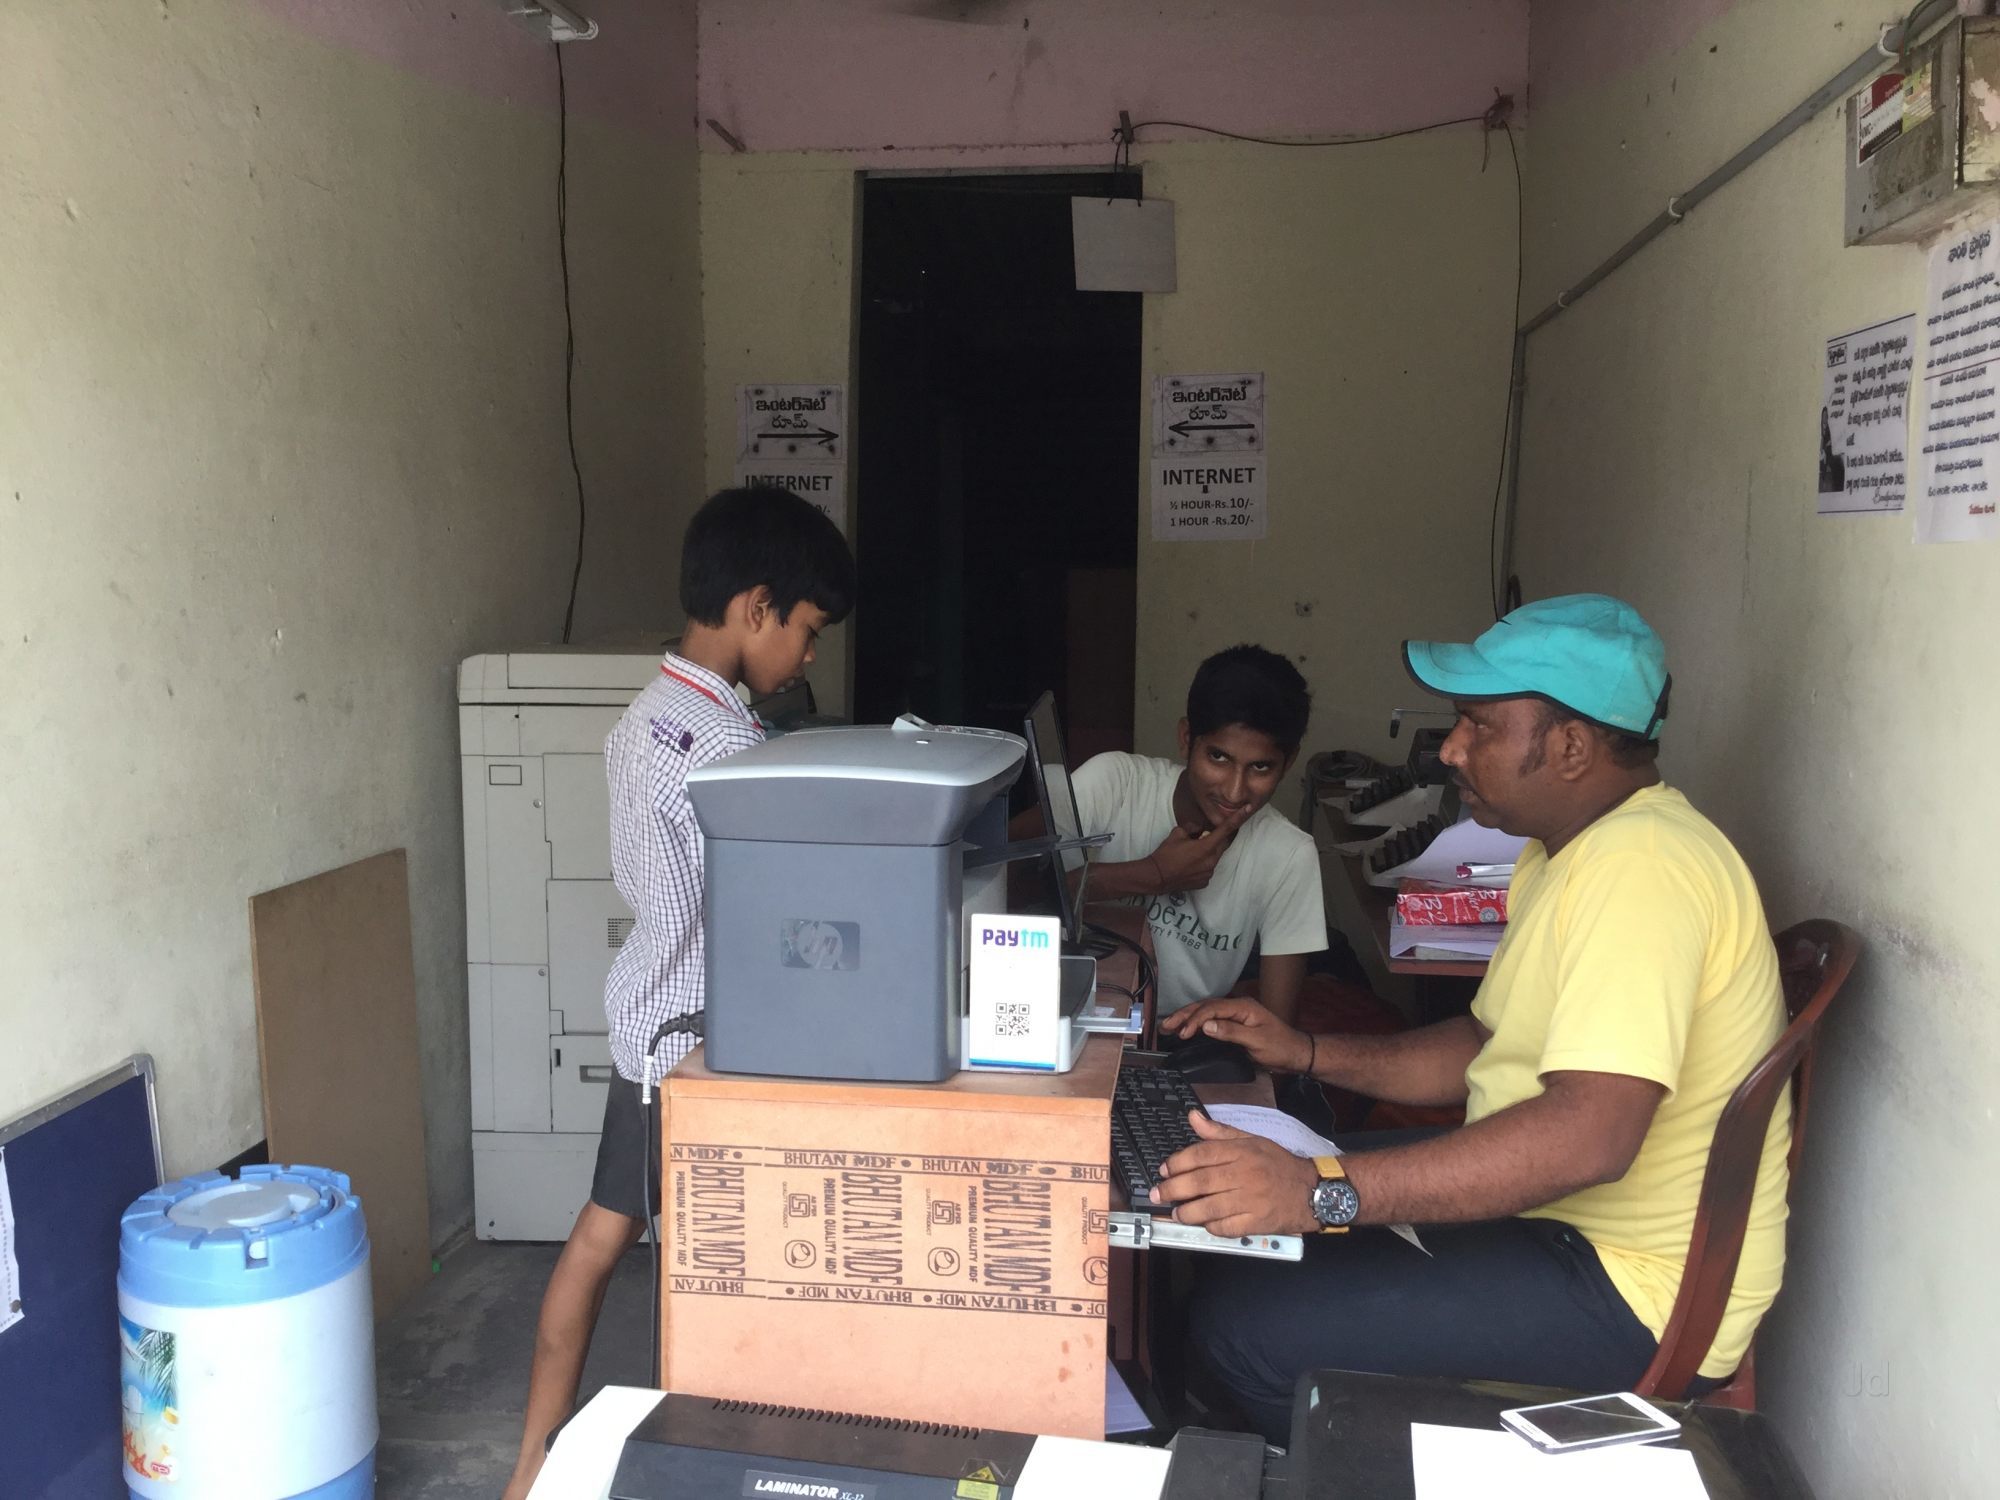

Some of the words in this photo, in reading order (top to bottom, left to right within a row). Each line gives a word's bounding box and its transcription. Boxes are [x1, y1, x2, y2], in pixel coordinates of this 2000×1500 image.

[1163, 467, 1256, 485] INTERNET
[1170, 518, 1175, 526] 1
[1179, 516, 1209, 526] HOUR
[687, 1147, 730, 1160] MDF
[784, 1152, 847, 1166] BHUTAN
[853, 1154, 897, 1168] MDF
[922, 1159, 981, 1173] BHUTAN
[986, 1162, 1034, 1176] MDF
[676, 1171, 685, 1208] PREMIUM
[690, 1164, 745, 1236] BHUTAN
[823, 1177, 836, 1215] PREMIUM
[968, 1185, 977, 1224] PREMIUM
[841, 1171, 903, 1244] BHUTAN
[983, 1179, 1052, 1252] BHUTAN
[676, 1211, 687, 1247] QUALITY
[824, 1219, 836, 1254] QUALITY
[968, 1226, 978, 1263] QUALITY
[677, 1249, 687, 1267] MDF
[692, 1238, 746, 1277] MDF
[825, 1257, 837, 1275] MDF
[842, 1246, 903, 1285] MDF
[675, 1278, 744, 1294] BHUTAN
[969, 1265, 978, 1284] MDF
[983, 1254, 1052, 1294] MDF
[799, 1286, 829, 1298] MDF
[835, 1288, 913, 1304] BHUTAN
[936, 1293, 967, 1306] MDF
[971, 1295, 1057, 1312] BHUTAN
[754, 1479, 840, 1499] LAMINATOR
